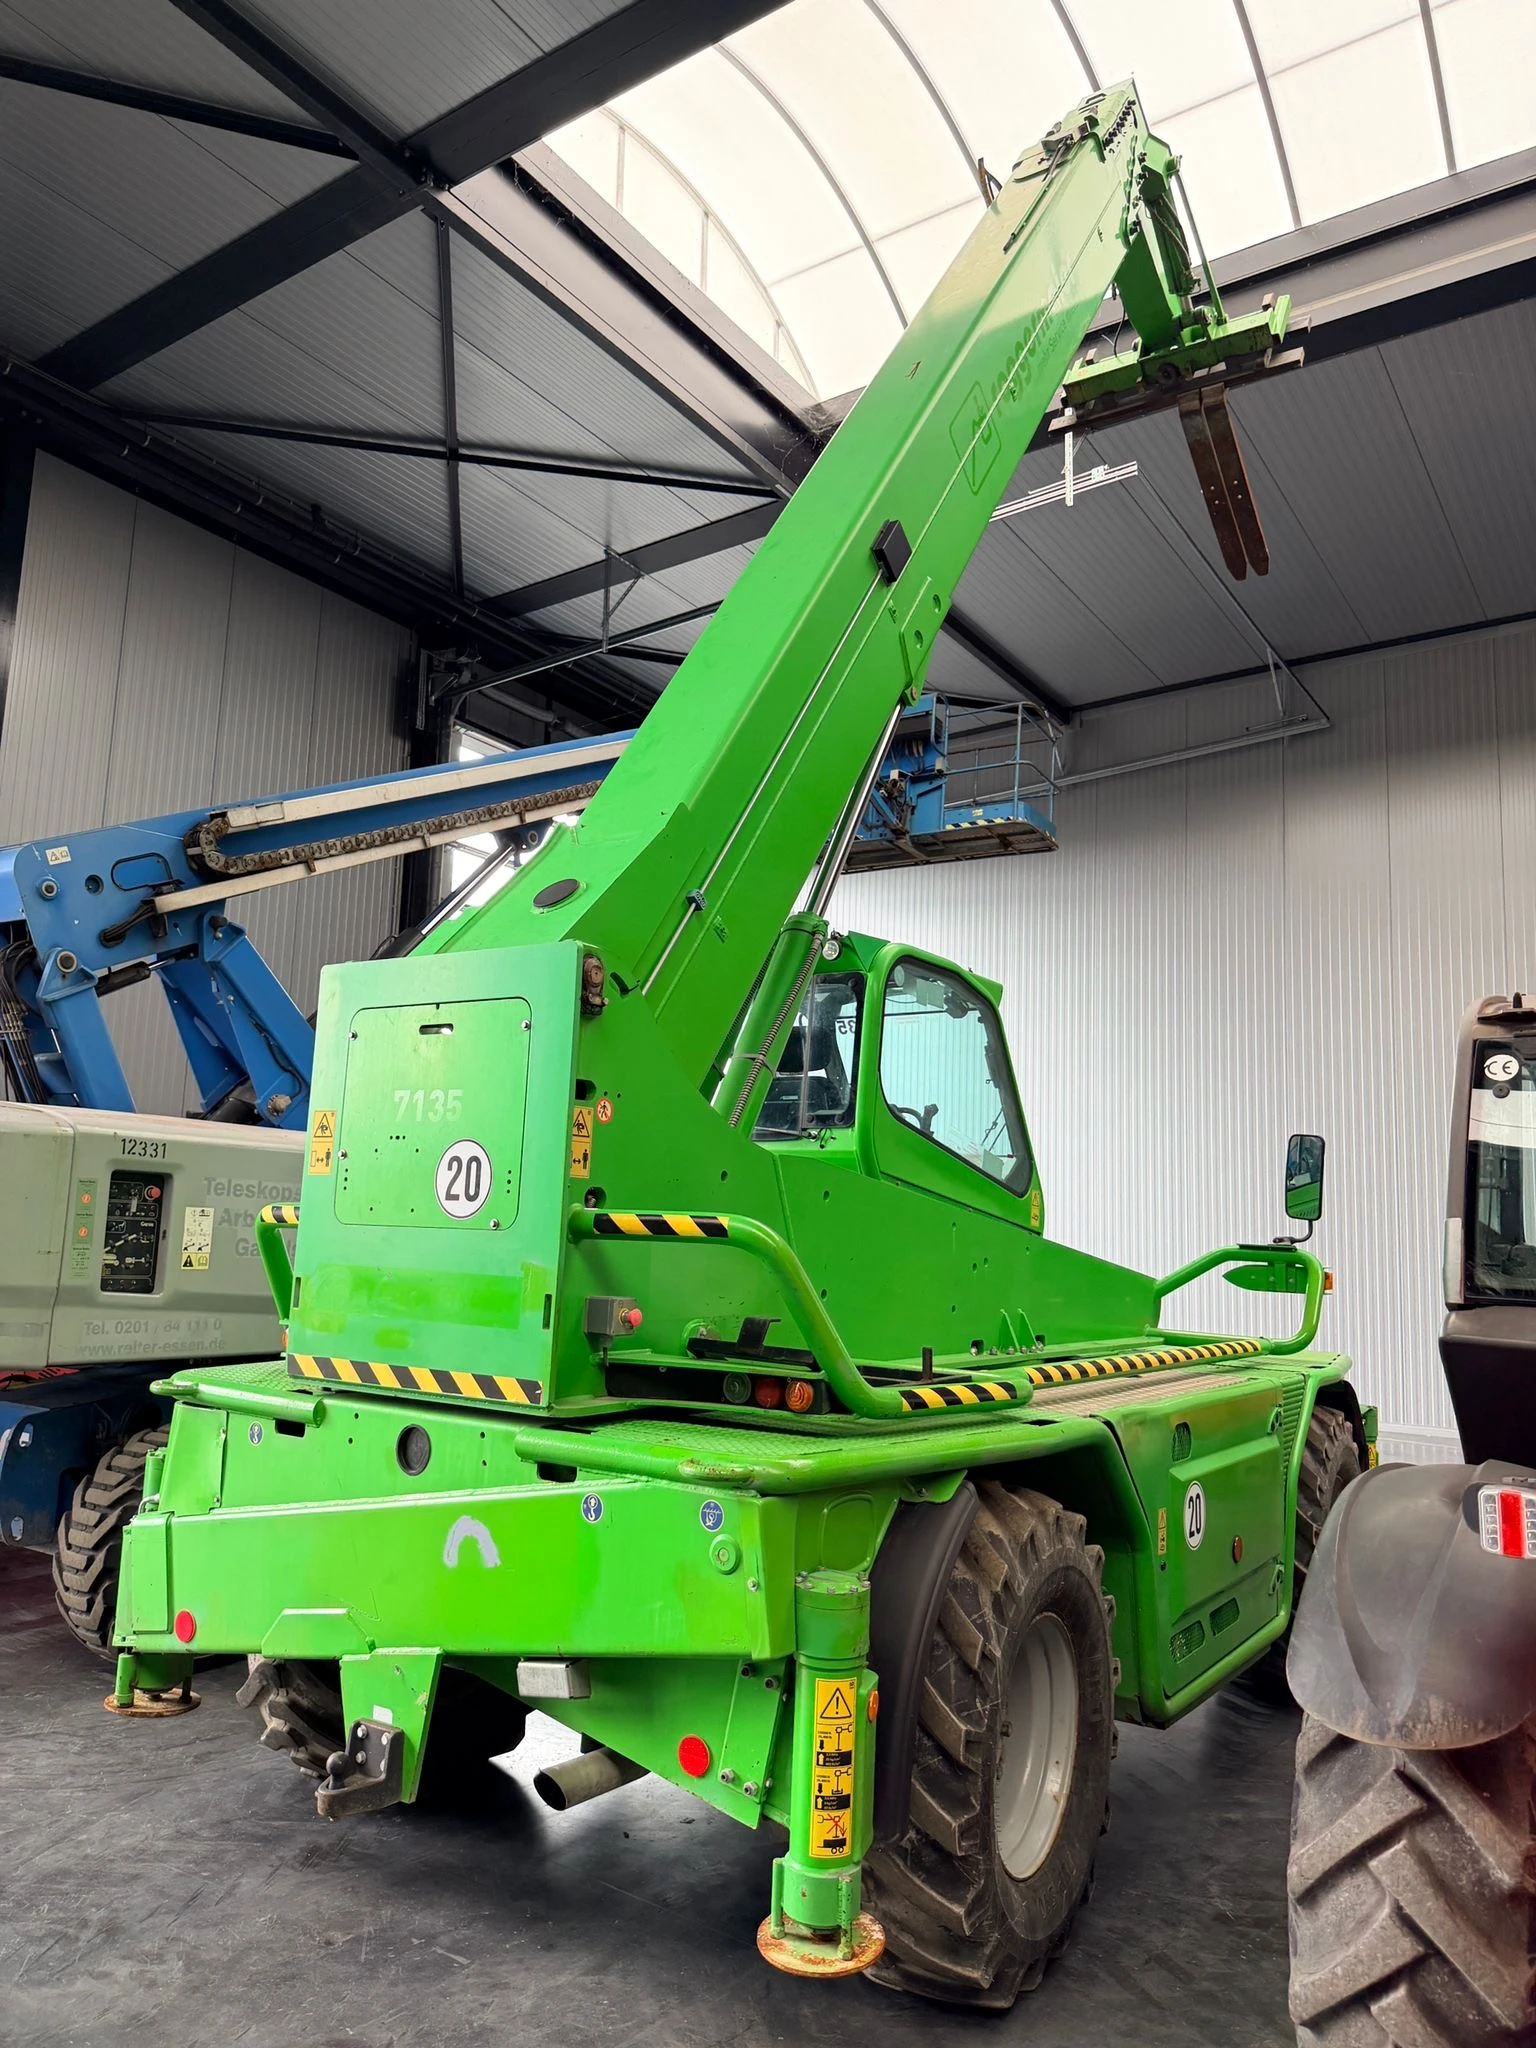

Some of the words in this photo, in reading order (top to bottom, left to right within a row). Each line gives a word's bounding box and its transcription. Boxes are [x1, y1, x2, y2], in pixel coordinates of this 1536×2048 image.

[1487, 1060, 1513, 1076] CE
[394, 1088, 464, 1122] 7135
[121, 1138, 167, 1160] 12331
[445, 1155, 482, 1203] 20
[83, 1321, 110, 1336] Tel.
[114, 1319, 150, 1335] 0201
[1187, 1492, 1202, 1539] 20
